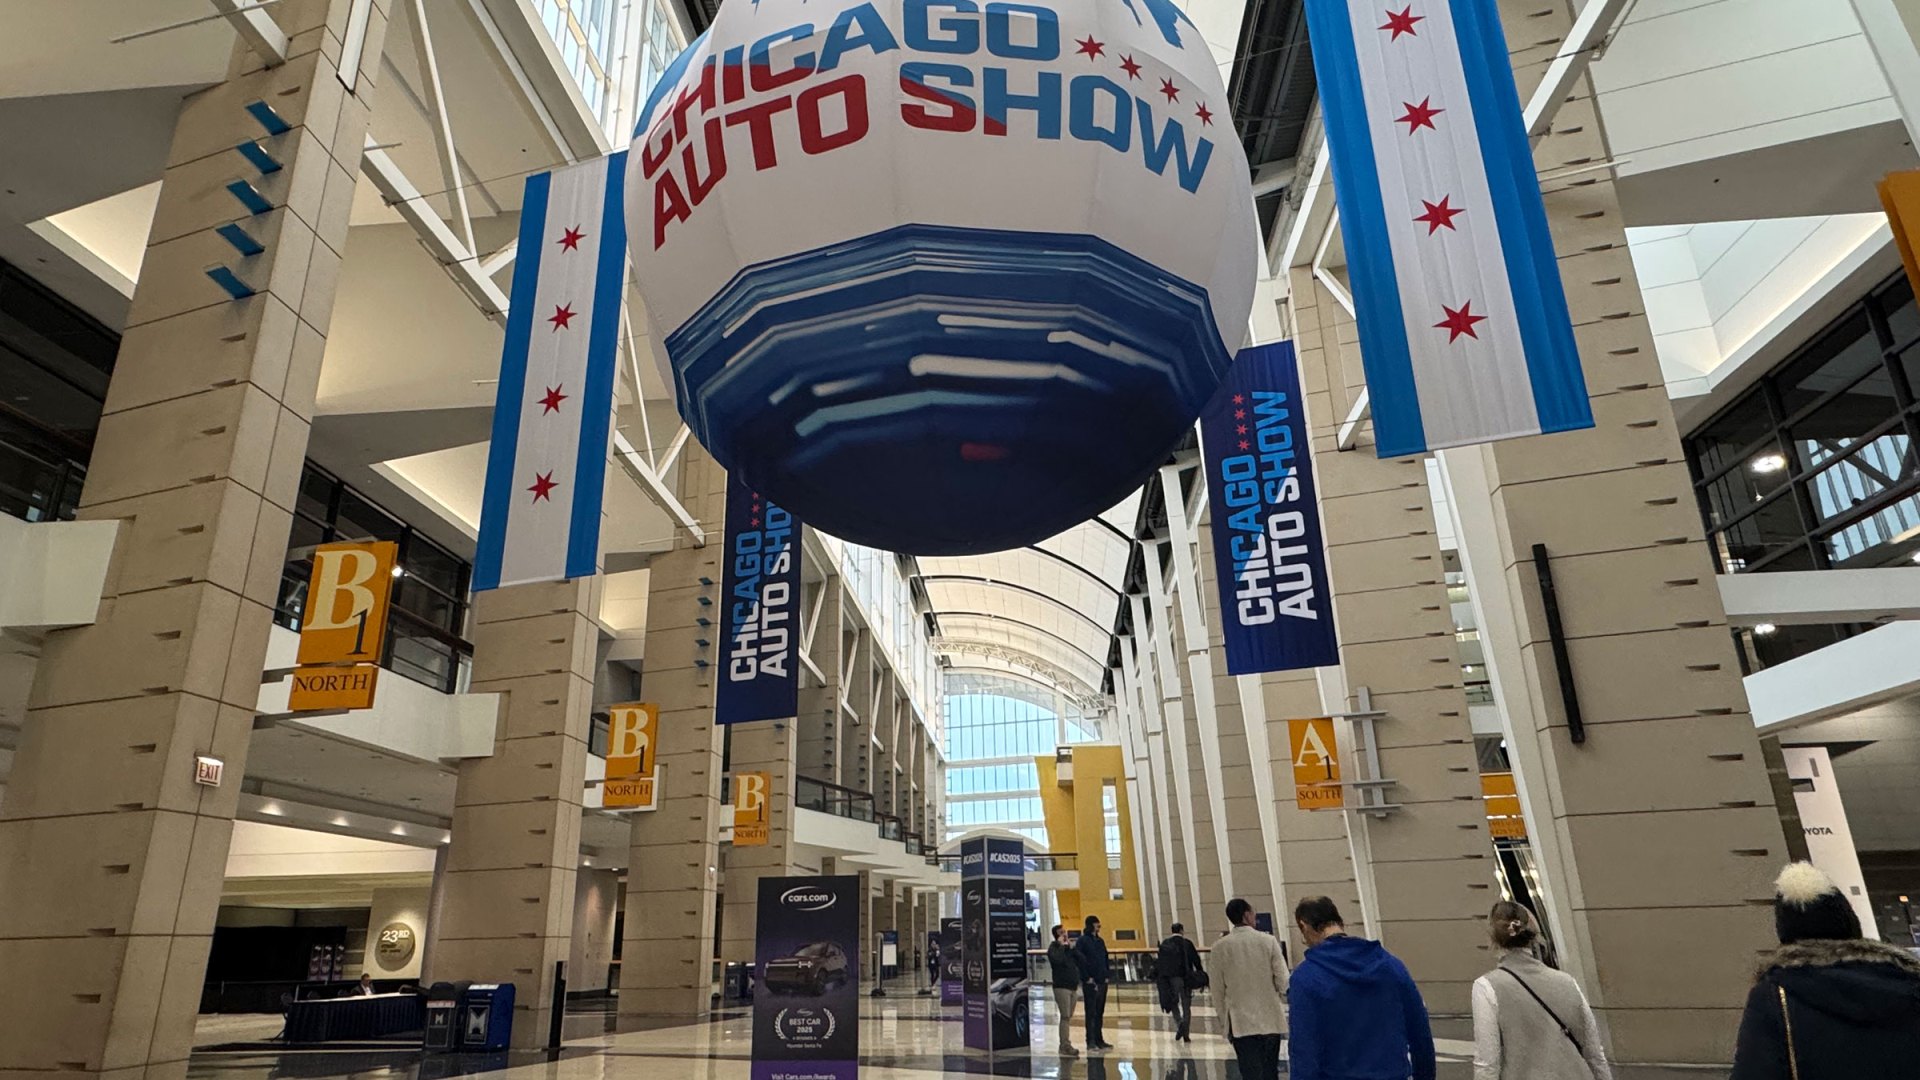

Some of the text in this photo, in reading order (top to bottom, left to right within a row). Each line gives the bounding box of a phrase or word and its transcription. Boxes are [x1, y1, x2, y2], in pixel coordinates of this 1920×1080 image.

[643, 0, 1060, 181] CHICAGO
[655, 61, 1214, 251] AUTO SHOW
[1251, 391, 1318, 620] AUTO SHOW
[1221, 454, 1275, 627] CHICAGO
[760, 500, 792, 678] AUTO SHO
[730, 531, 762, 682] CHICAGO
[294, 673, 368, 693] NORTH
[199, 763, 220, 780] EXIT
[605, 783, 649, 796] NORTH
[1299, 789, 1341, 800] SOUTH
[735, 829, 767, 839] NORTH
[788, 894, 829, 902] cars.com
[789, 1018, 805, 1026] BEST
